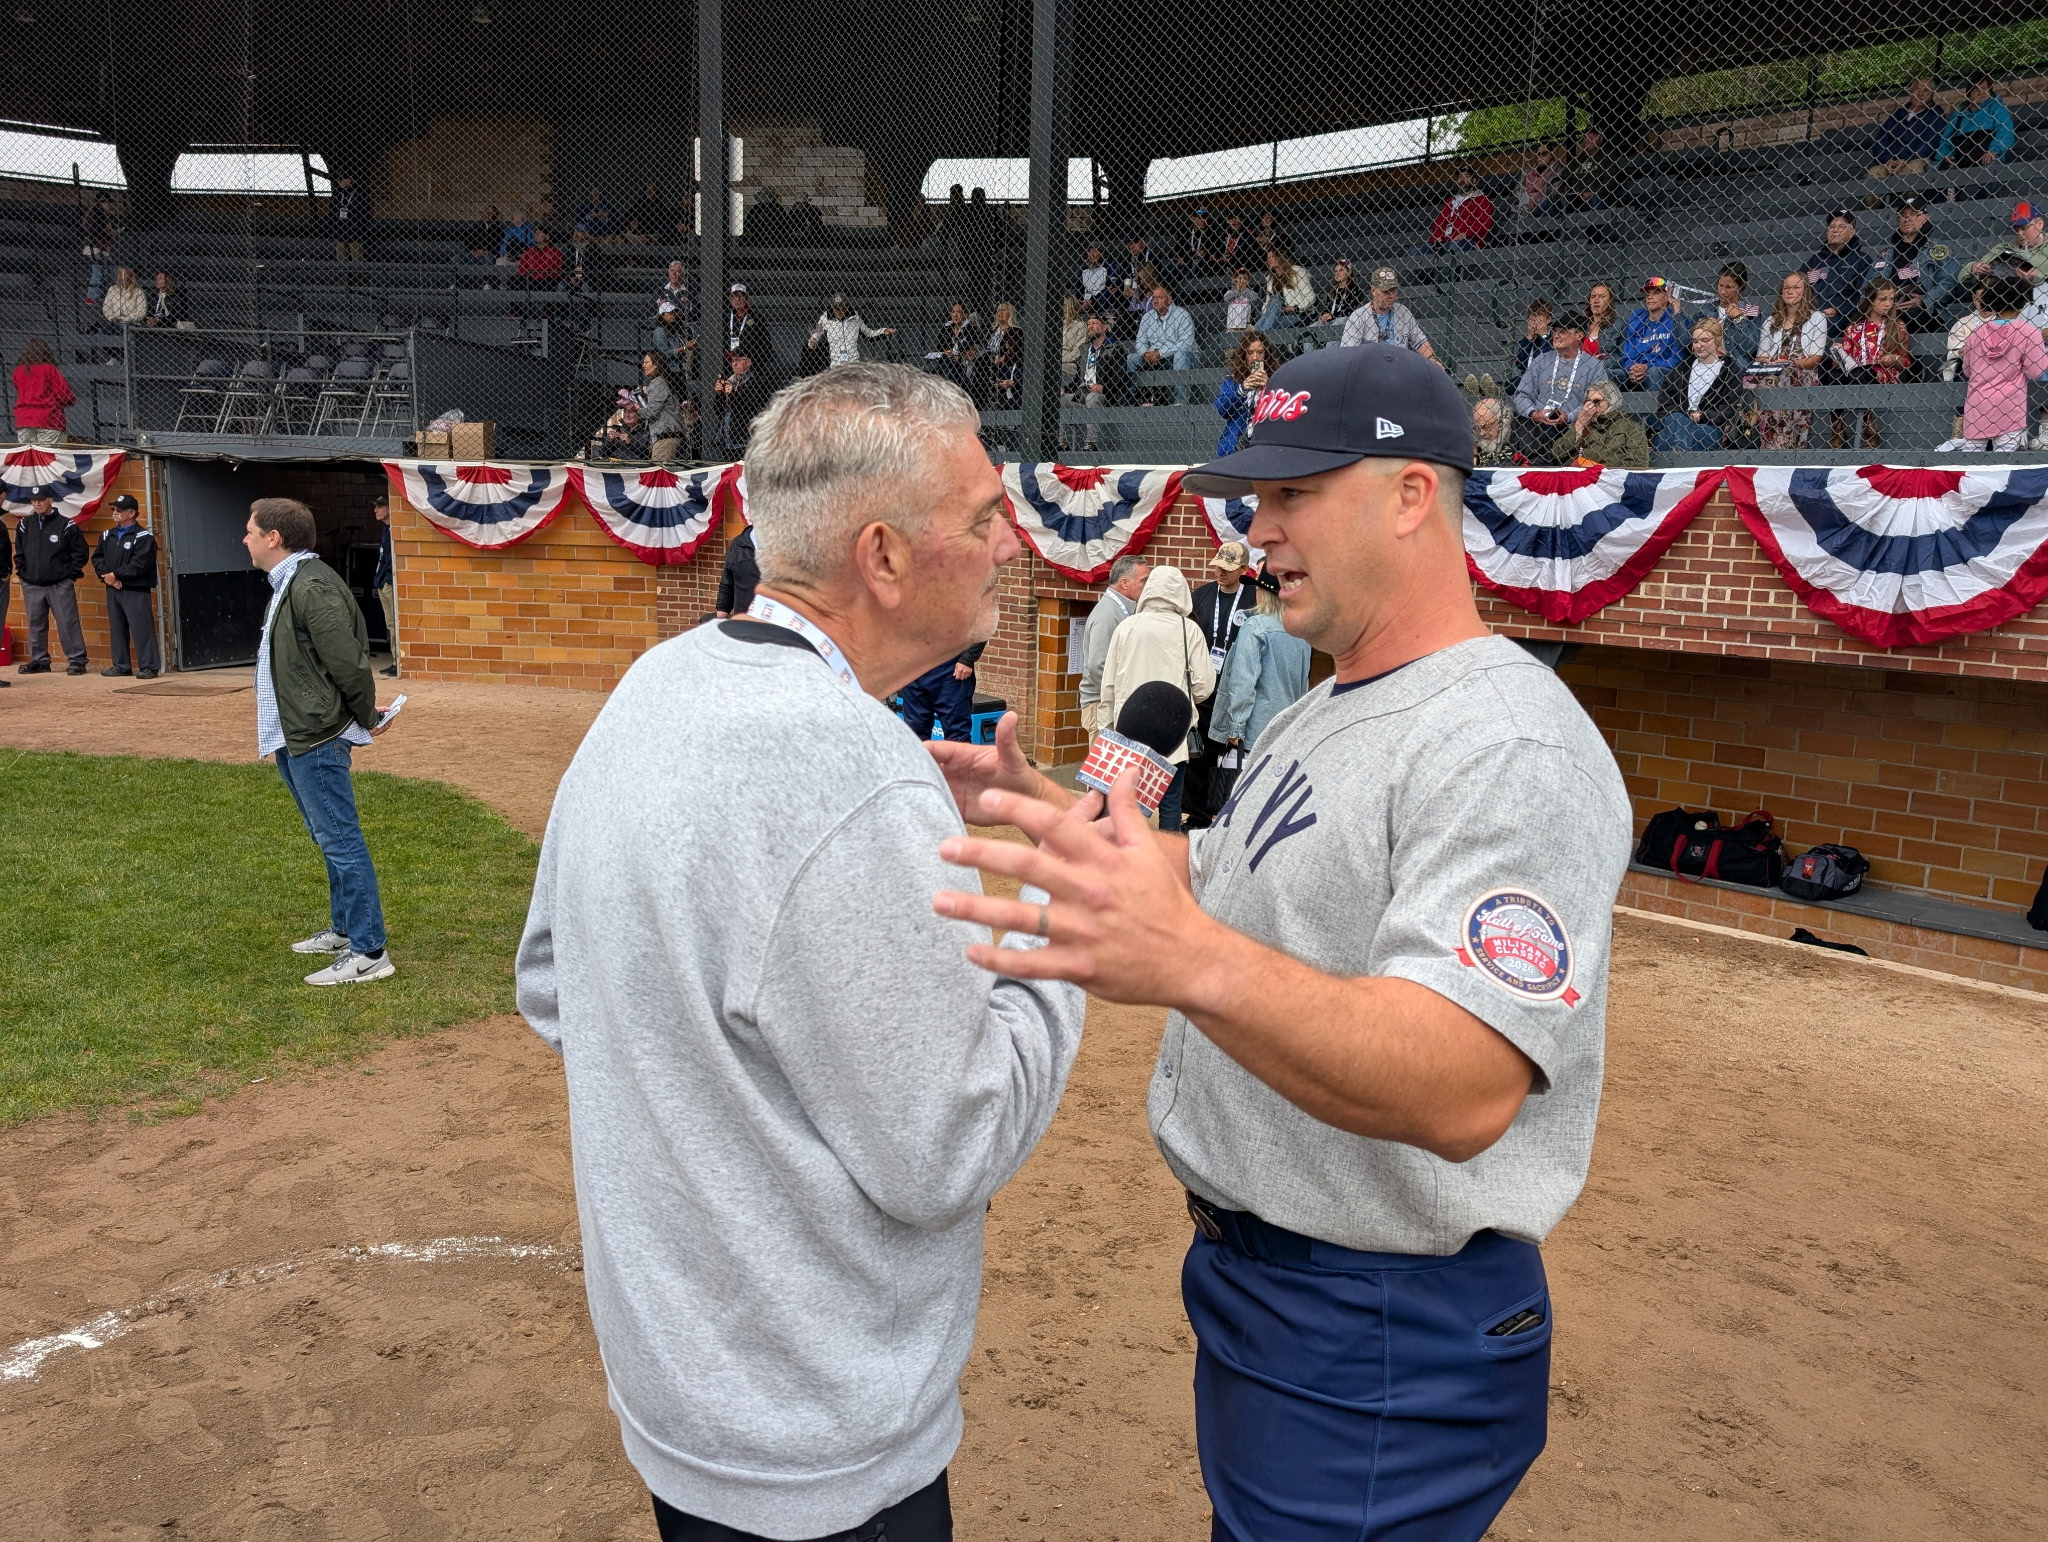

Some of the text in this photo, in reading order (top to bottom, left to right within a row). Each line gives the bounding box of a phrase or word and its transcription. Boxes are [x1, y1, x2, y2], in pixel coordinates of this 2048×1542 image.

[1207, 753, 1318, 875] AVY
[1504, 896, 1543, 914] TRIBUTE
[1545, 914, 1555, 926] TO
[1476, 909, 1565, 951] Hall of Fame
[1493, 938, 1550, 963] MILITARY
[1495, 946, 1547, 969] CLASSIC
[1475, 947, 1561, 991] SERVICE AND SACRIFICE
